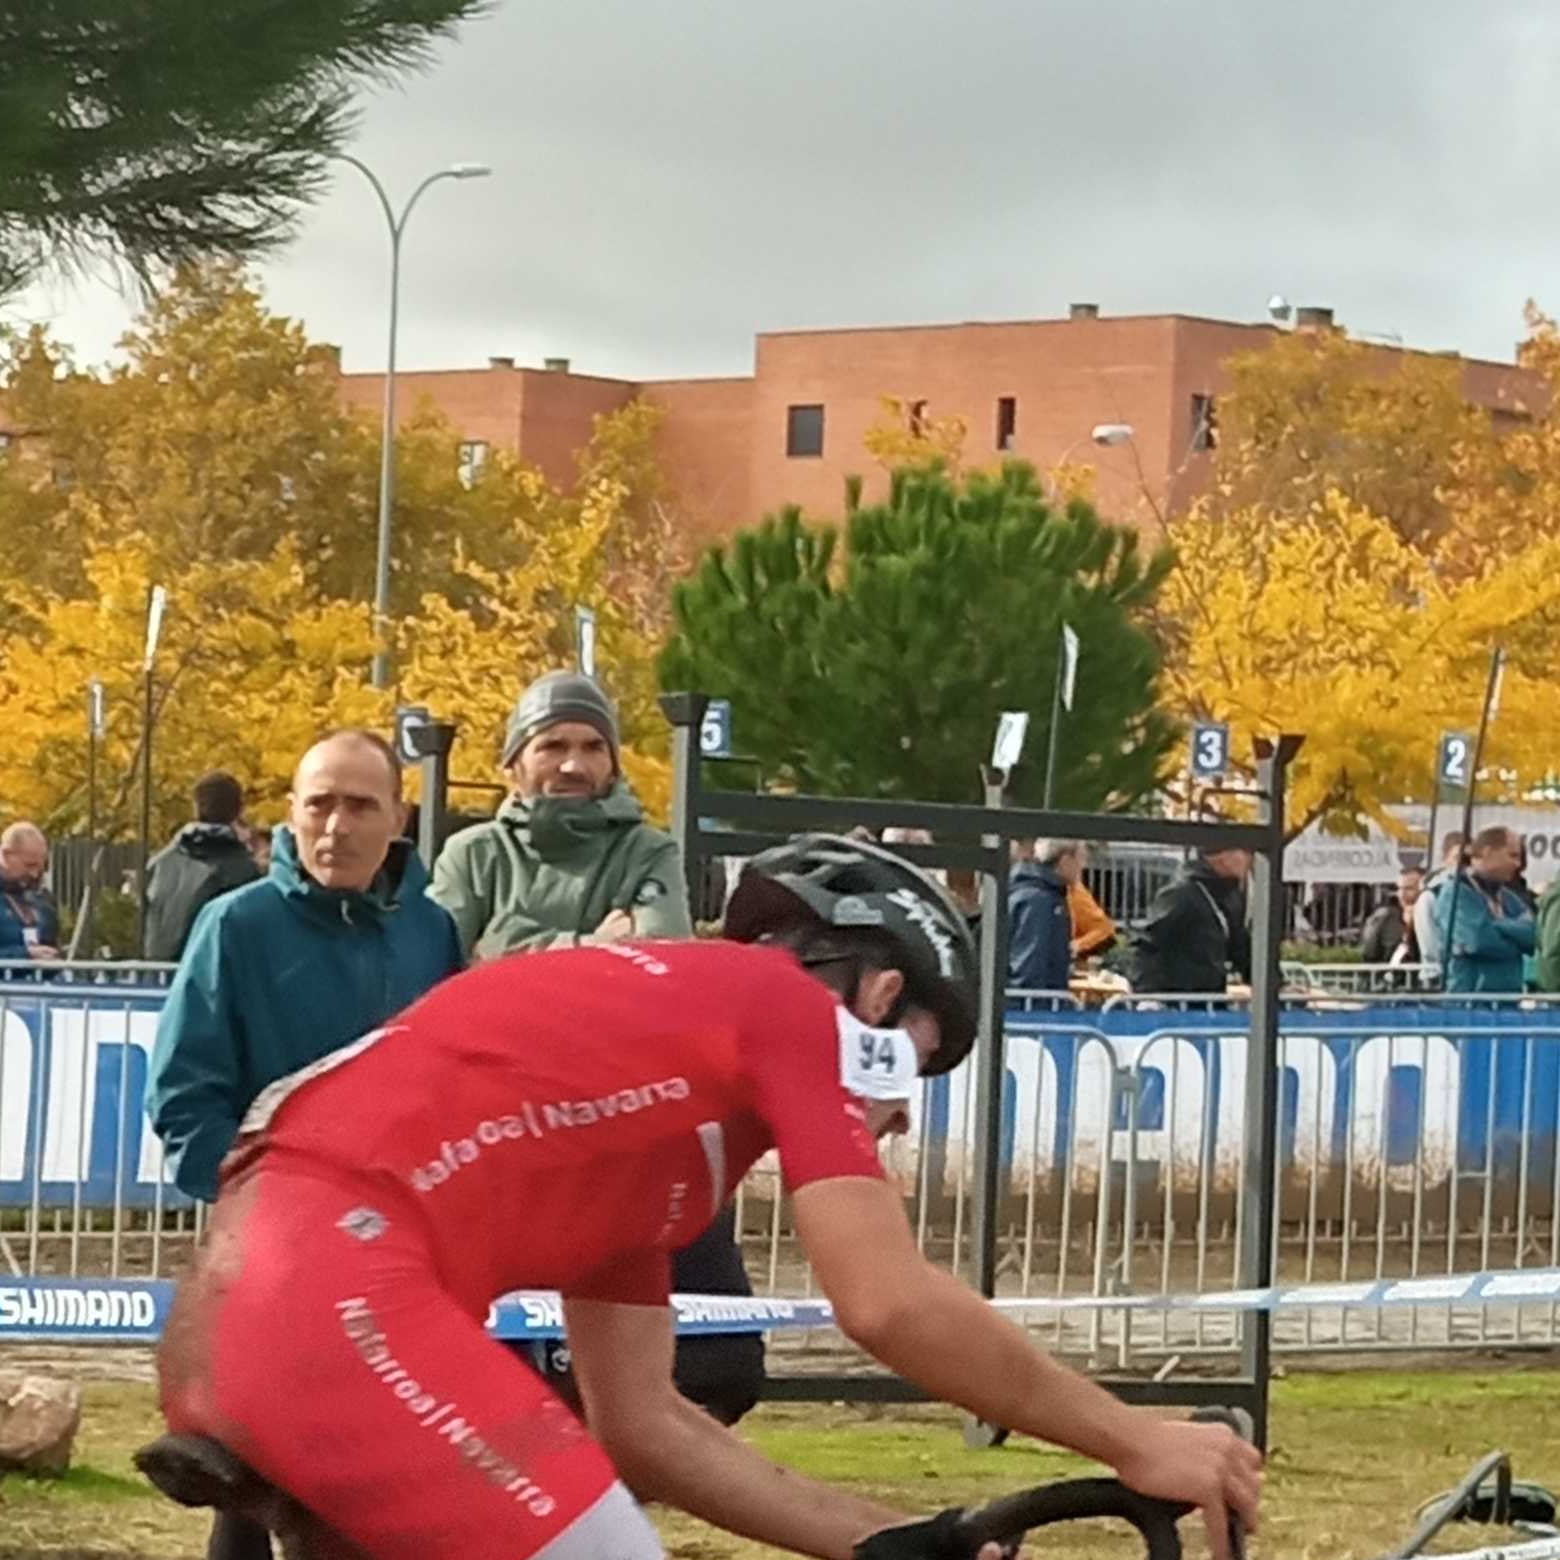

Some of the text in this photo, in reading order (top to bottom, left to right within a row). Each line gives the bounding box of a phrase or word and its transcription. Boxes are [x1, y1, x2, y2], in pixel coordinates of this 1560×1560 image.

[1197, 730, 1223, 769] 3
[1445, 739, 1466, 776] 2
[858, 1032, 897, 1074] 94
